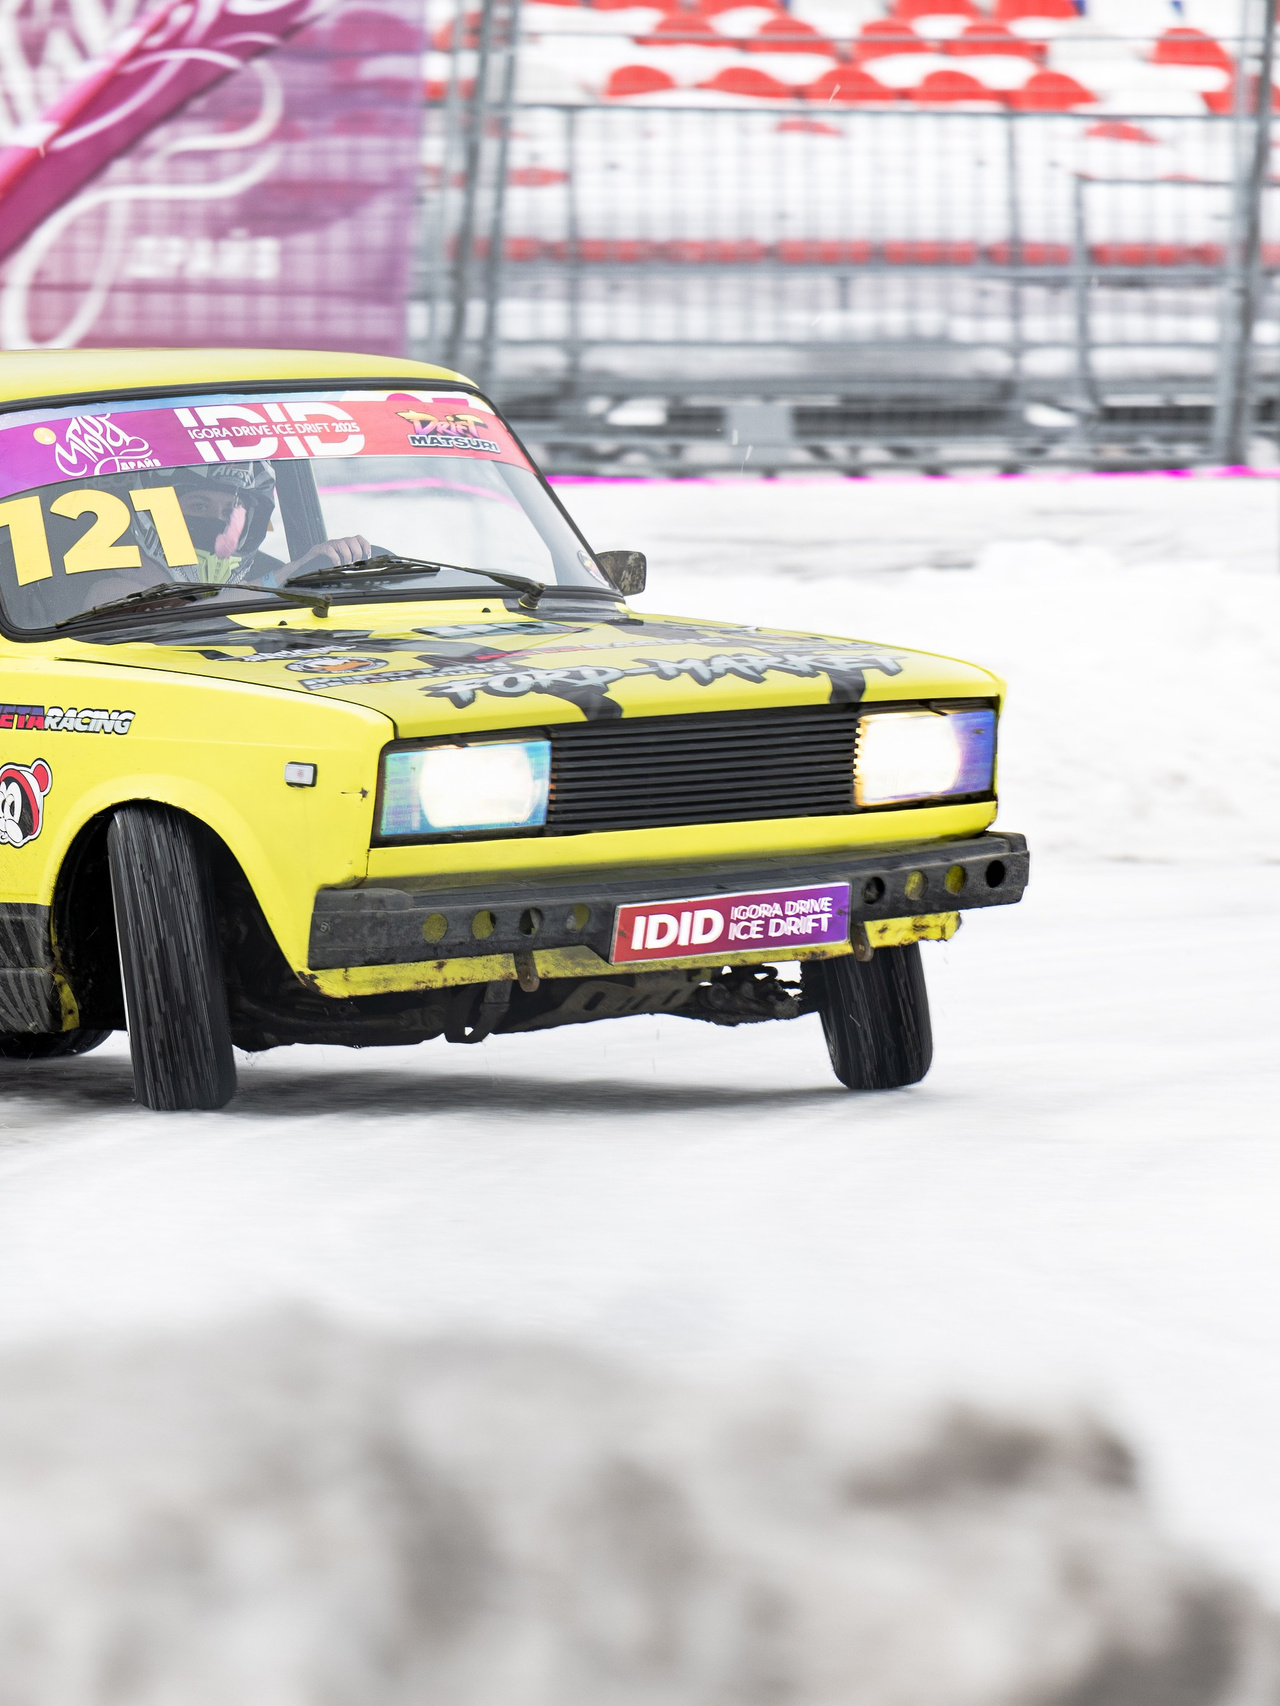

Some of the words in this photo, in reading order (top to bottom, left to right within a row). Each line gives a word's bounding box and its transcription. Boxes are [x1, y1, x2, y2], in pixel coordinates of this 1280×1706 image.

[187, 427, 232, 440] IGORA
[232, 425, 271, 437] DRIVE
[272, 423, 296, 435] ICE
[294, 422, 331, 434] DRIFT
[331, 421, 361, 433] 2025
[408, 434, 501, 454] MATSURI
[730, 902, 783, 921] IGORA
[784, 896, 834, 916] DRIVE
[631, 908, 725, 950] IDID
[728, 919, 766, 941] ICE
[768, 912, 833, 938] DRIFT
